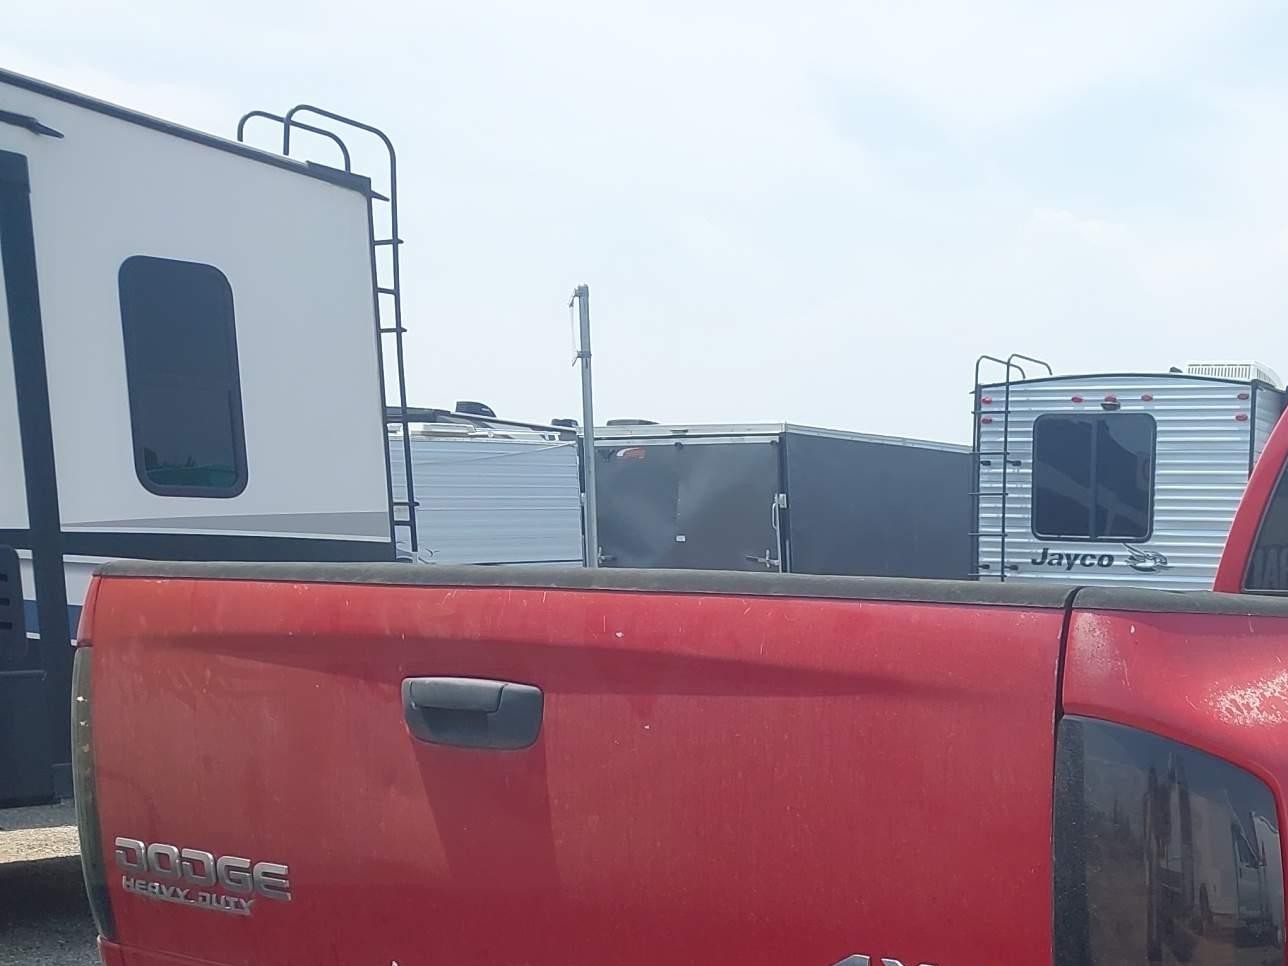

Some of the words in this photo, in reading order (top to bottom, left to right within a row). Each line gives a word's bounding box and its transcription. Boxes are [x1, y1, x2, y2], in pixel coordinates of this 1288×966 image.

[1031, 547, 1115, 571] Jayco
[115, 836, 292, 901] DODGE
[122, 874, 190, 903] HEAVY
[198, 891, 255, 916] DUTY
